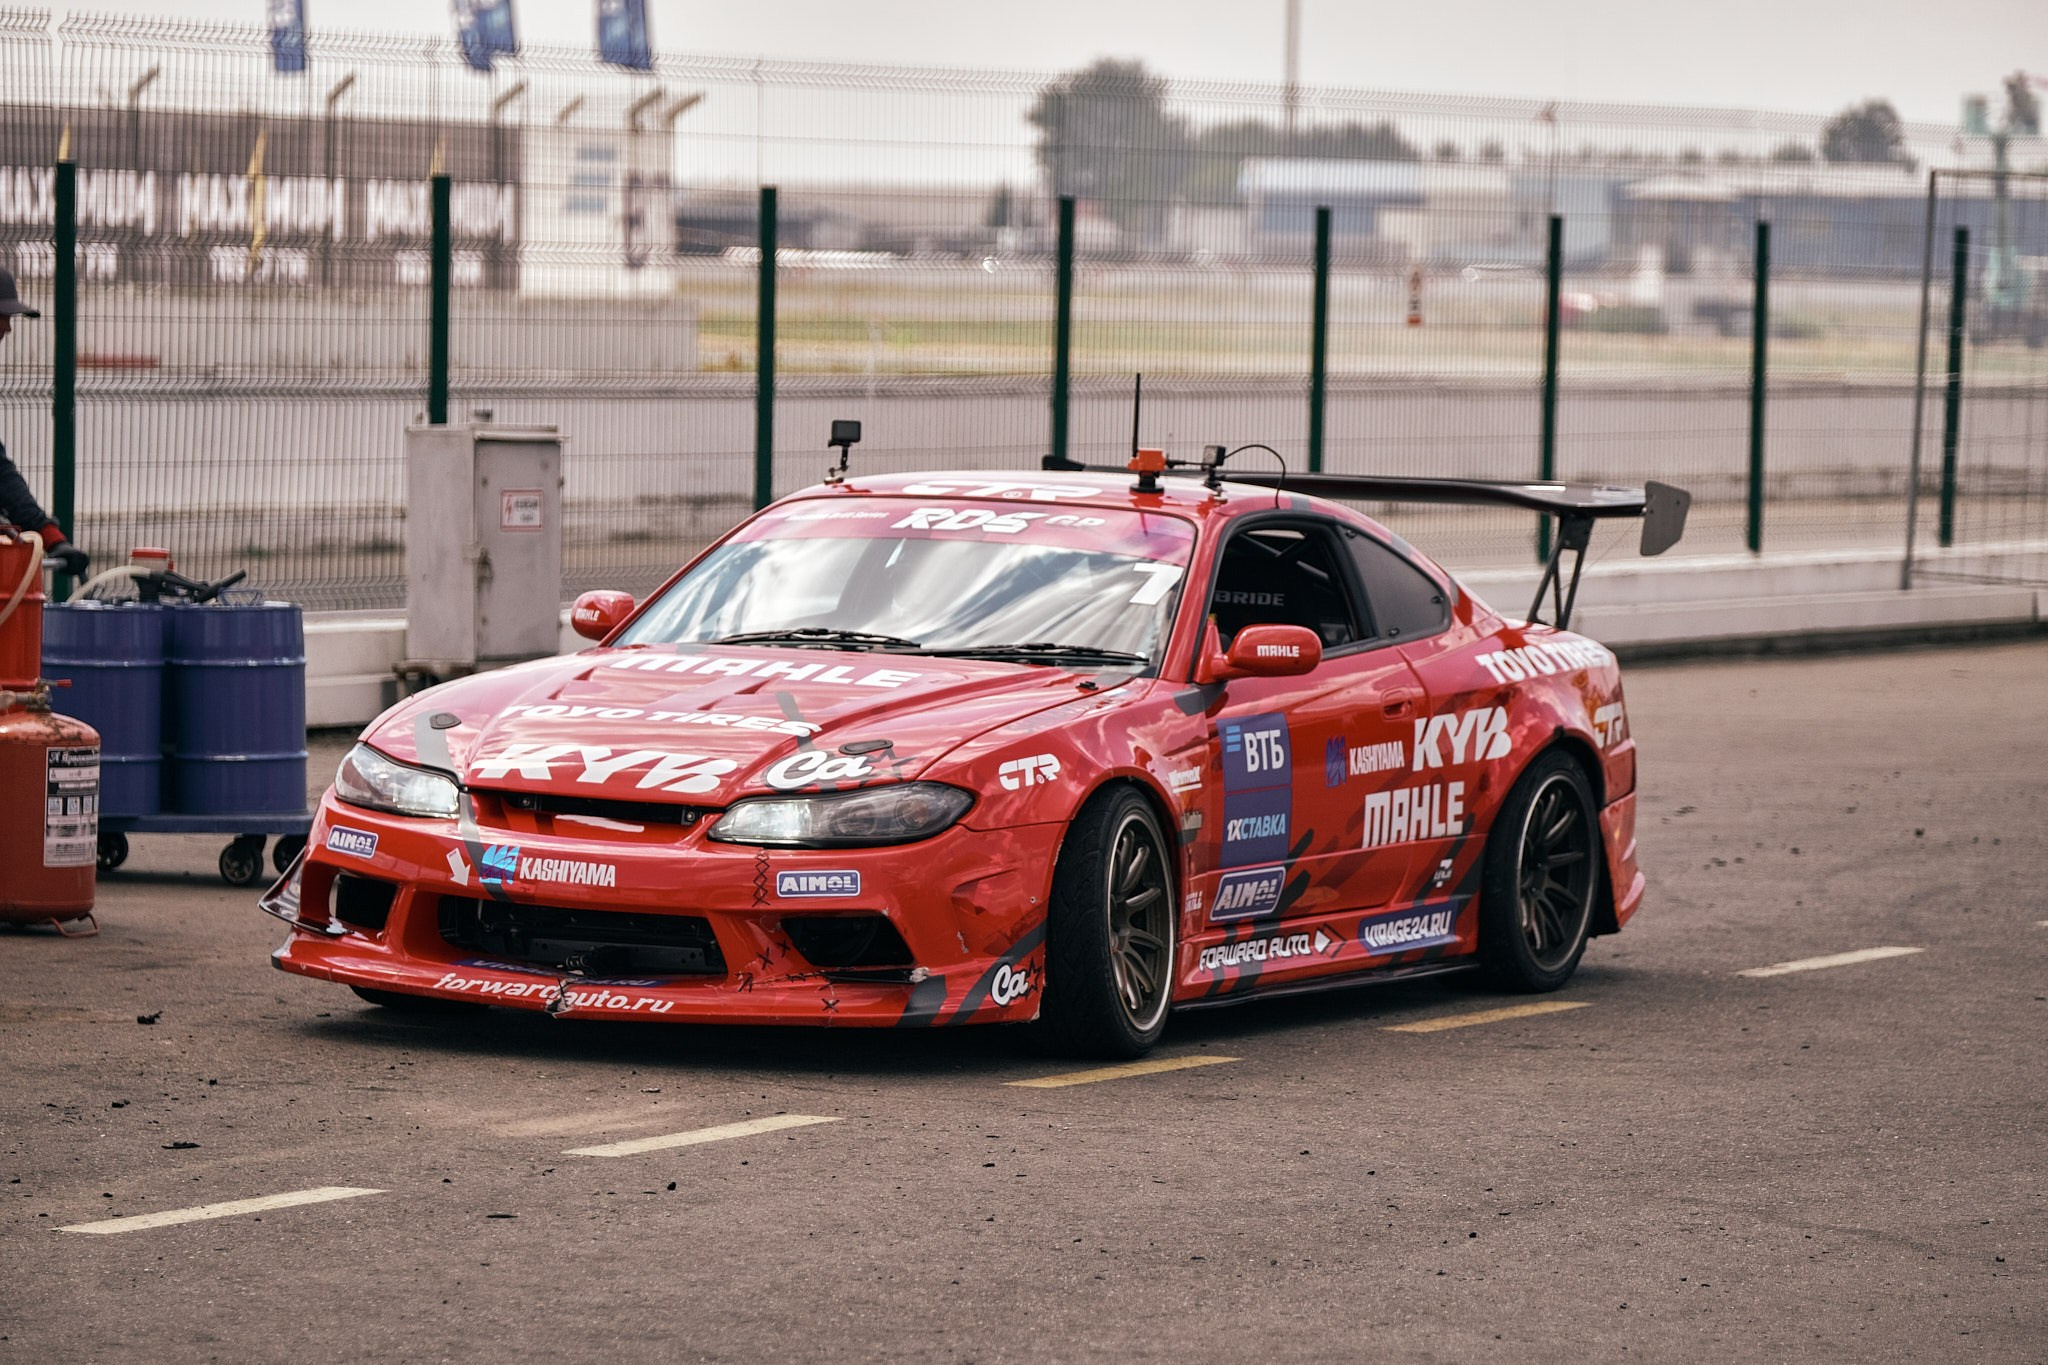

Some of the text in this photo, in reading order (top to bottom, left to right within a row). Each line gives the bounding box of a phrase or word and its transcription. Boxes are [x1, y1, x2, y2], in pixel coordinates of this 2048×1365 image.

[890, 508, 1049, 534] RDS
[1044, 515, 1106, 527] GP
[1129, 562, 1185, 606] 7
[1213, 590, 1285, 606] BRIDE
[1256, 644, 1300, 658] MAHLE
[1475, 644, 1557, 685] TOYO
[610, 655, 923, 688] MAHLE
[499, 703, 822, 738] TOYO TIRES
[1412, 705, 1512, 772] KYB
[470, 743, 738, 794] KYB
[1243, 729, 1285, 773] ВТБ
[1350, 740, 1405, 776] KASHIYAMA
[998, 753, 1062, 791] CTR
[1361, 781, 1465, 849] MAHLE
[329, 831, 374, 852] AIMOL
[519, 857, 617, 888] KASHIYAMA
[780, 875, 857, 892] AIMOL
[1215, 878, 1278, 911] AIMOL
[1364, 910, 1453, 948] VIRAGE24.RU
[1199, 933, 1312, 972] FORWARD AUTO
[991, 963, 1029, 1006] Ca
